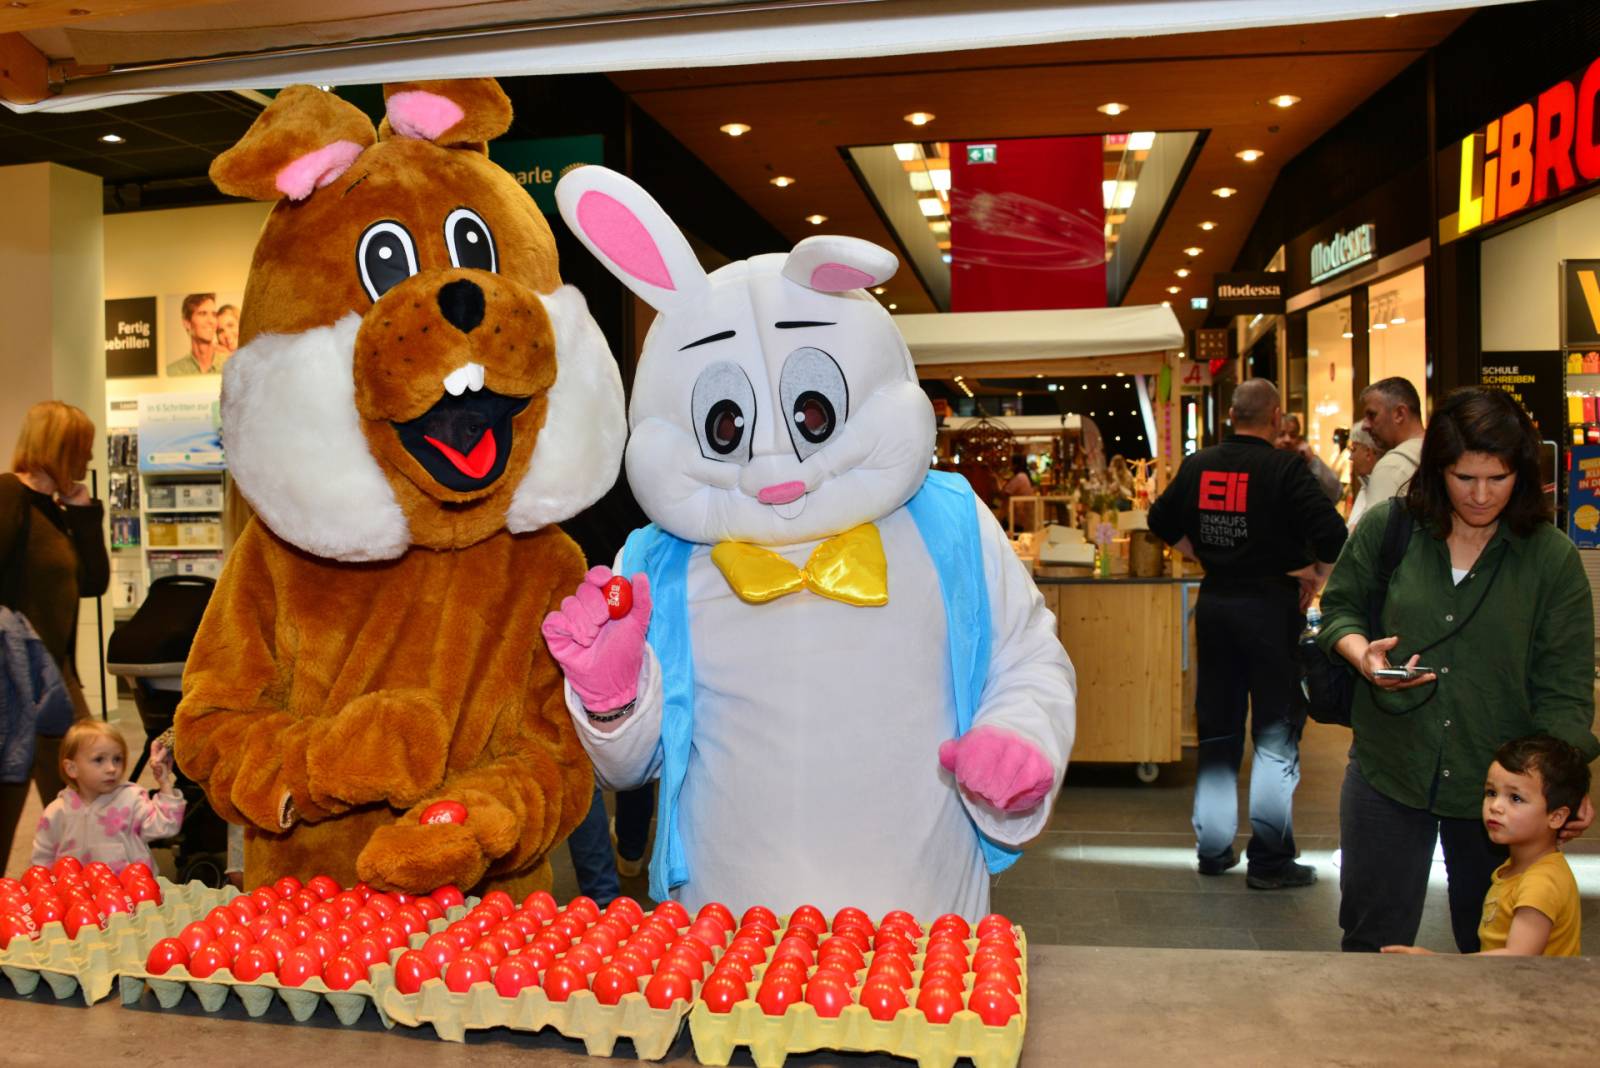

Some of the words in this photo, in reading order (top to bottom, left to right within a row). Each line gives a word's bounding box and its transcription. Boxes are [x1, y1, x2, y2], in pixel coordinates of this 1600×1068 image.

[118, 320, 150, 336] Fertig
[1482, 366, 1519, 375] SCHULE
[1482, 375, 1535, 384] SCHREIBEN
[1199, 470, 1249, 513] Eli
